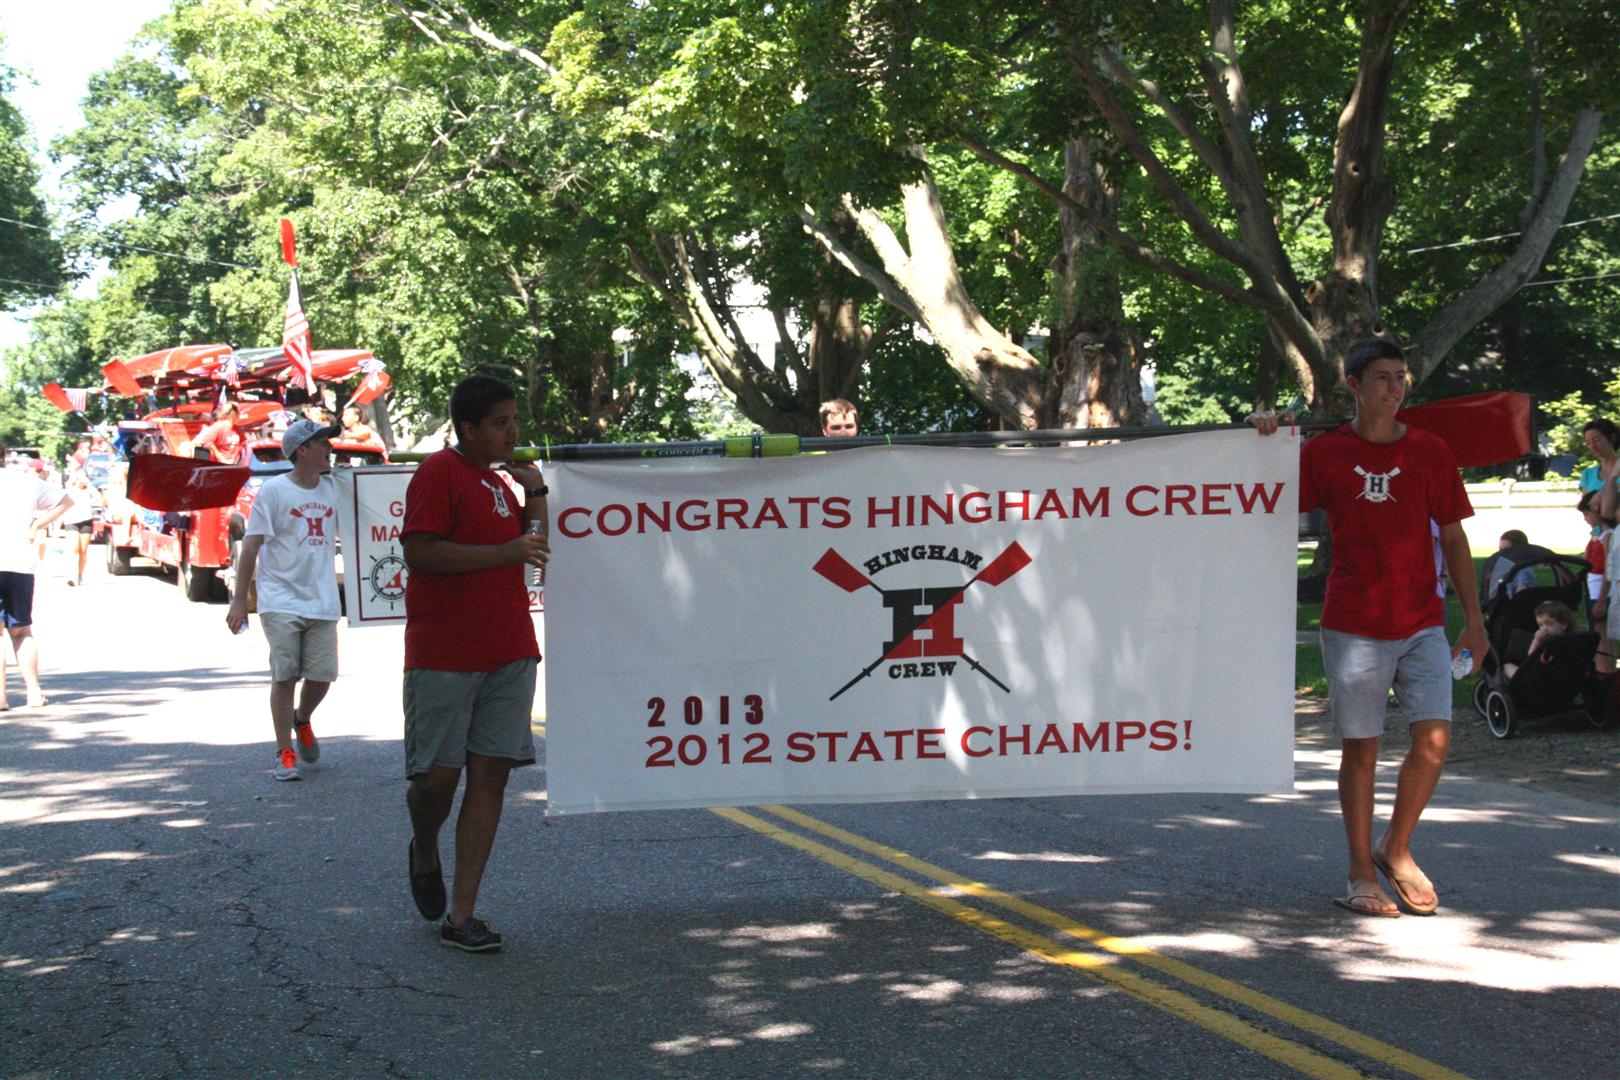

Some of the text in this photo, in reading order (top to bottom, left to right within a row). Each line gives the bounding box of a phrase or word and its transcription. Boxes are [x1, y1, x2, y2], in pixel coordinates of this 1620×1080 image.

[1369, 476, 1385, 493] H
[306, 517, 325, 537] H
[557, 482, 1286, 539] CONGRATS HINGHAM CREW
[863, 544, 983, 576] HINGHAM
[882, 586, 965, 661] H
[888, 661, 957, 679] CREW
[646, 694, 764, 728] 2013
[645, 719, 1193, 768] 2012 STATE CHAMPS!
